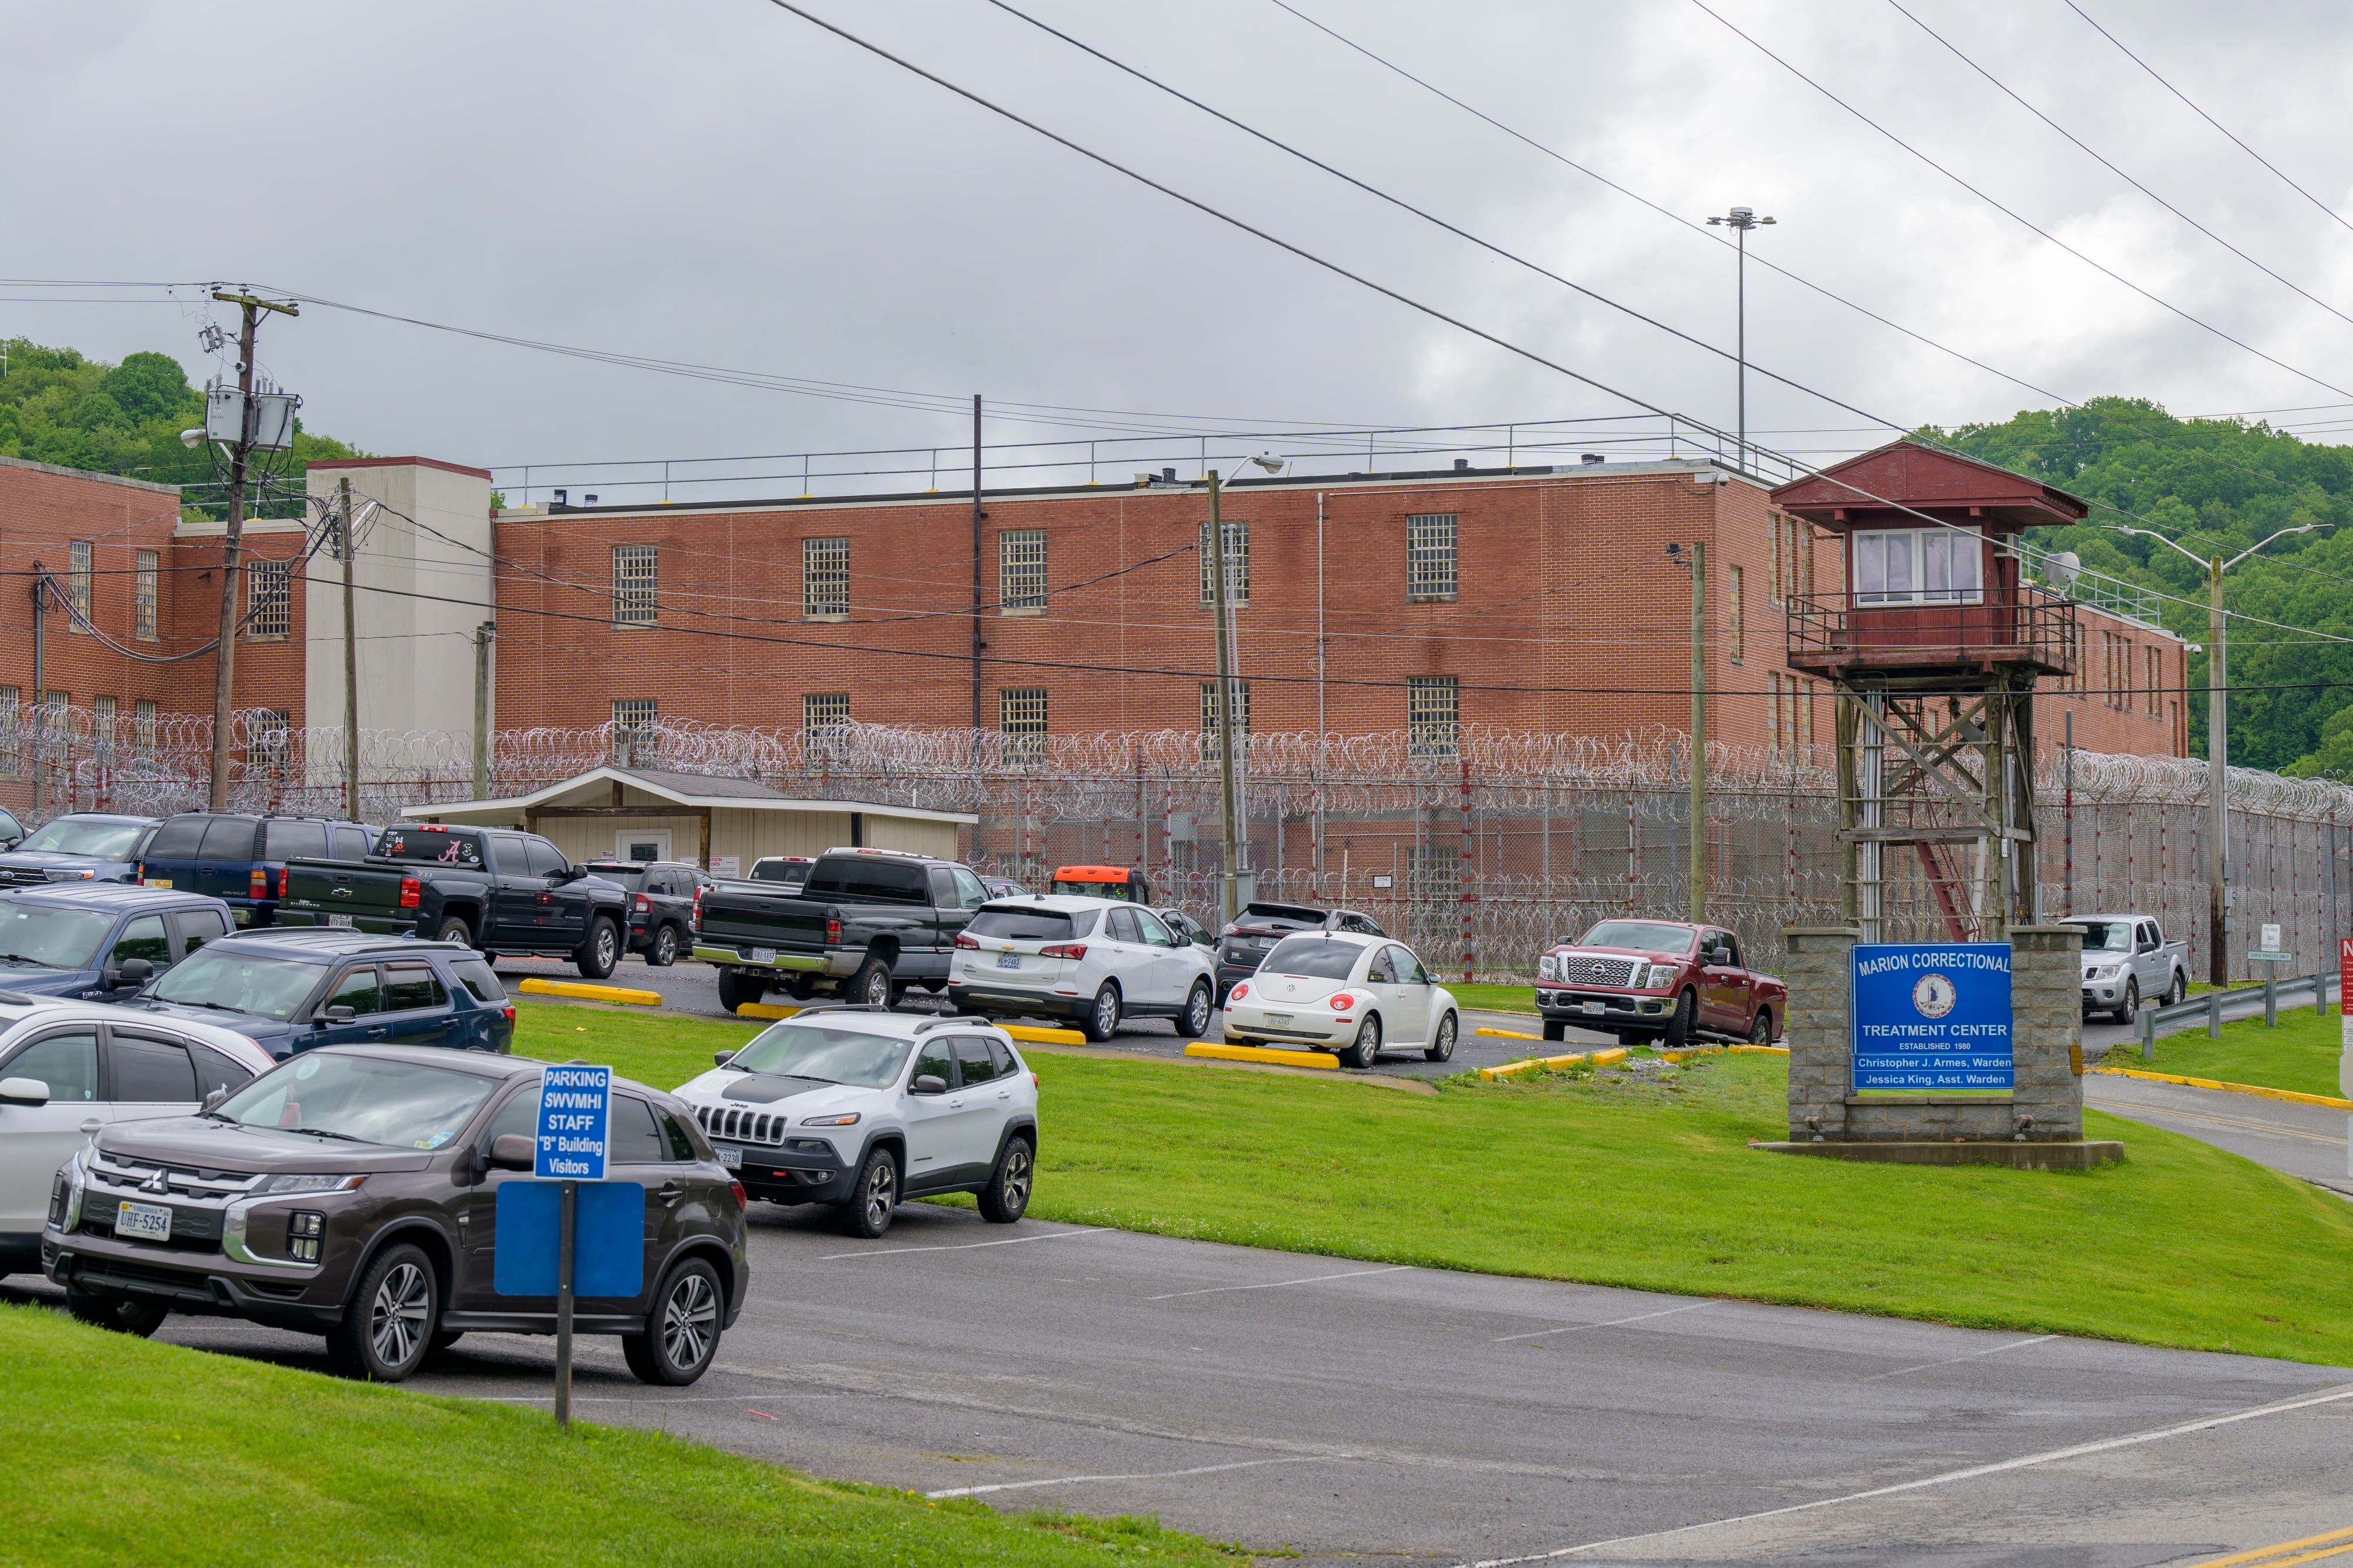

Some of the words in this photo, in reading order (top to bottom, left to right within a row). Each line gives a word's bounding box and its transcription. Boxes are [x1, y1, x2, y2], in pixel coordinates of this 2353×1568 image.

[1858, 954, 1909, 977] MARION
[1912, 952, 2011, 973] CORRECTIONAL
[1862, 1025, 1947, 1036] TREATMENT
[1951, 1025, 2007, 1036] CENTER
[1858, 1058, 1919, 1069] Christopher
[1922, 1059, 1931, 1067] J.
[1934, 1059, 1969, 1069] Armes,
[1972, 1058, 2012, 1067] Warden
[545, 1070, 606, 1087] PARKING
[1866, 1075, 1905, 1084] Jessica
[1908, 1075, 1934, 1086] King,
[1937, 1075, 1963, 1084] Asst.
[1966, 1075, 2005, 1083] Warden
[544, 1092, 602, 1109] SWVMHI
[548, 1114, 594, 1131] STAFF
[539, 1135, 556, 1152] "B"
[558, 1136, 604, 1157] Building
[549, 1157, 589, 1175] Visitors
[133, 1206, 158, 1215] VIRGINIA
[121, 1211, 167, 1232] UHF-5254
